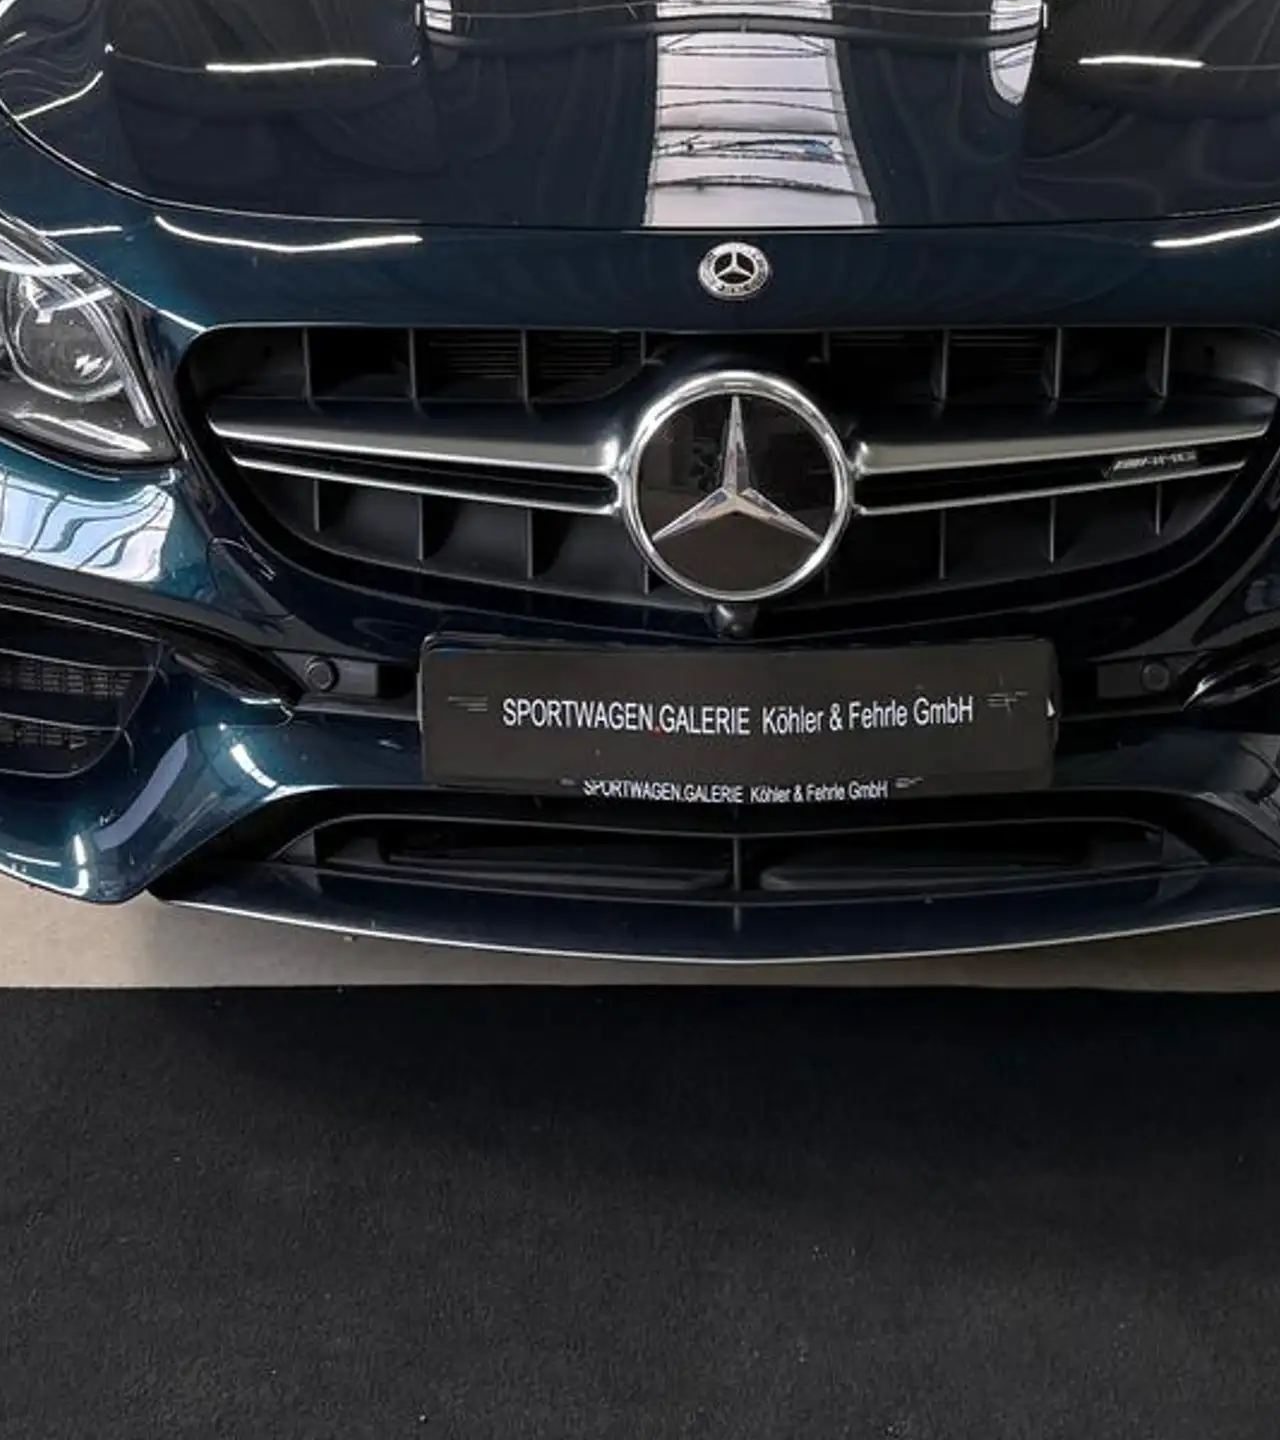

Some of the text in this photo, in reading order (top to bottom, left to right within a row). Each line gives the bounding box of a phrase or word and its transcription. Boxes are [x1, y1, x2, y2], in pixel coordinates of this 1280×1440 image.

[762, 705, 825, 735] Köhler
[829, 702, 844, 732] &
[848, 699, 908, 730] Fehrle
[913, 695, 974, 726] GmbH
[750, 785, 792, 804] Köhler
[793, 784, 804, 803] &
[805, 782, 846, 802] Fehrle
[848, 780, 889, 800] GmbH
